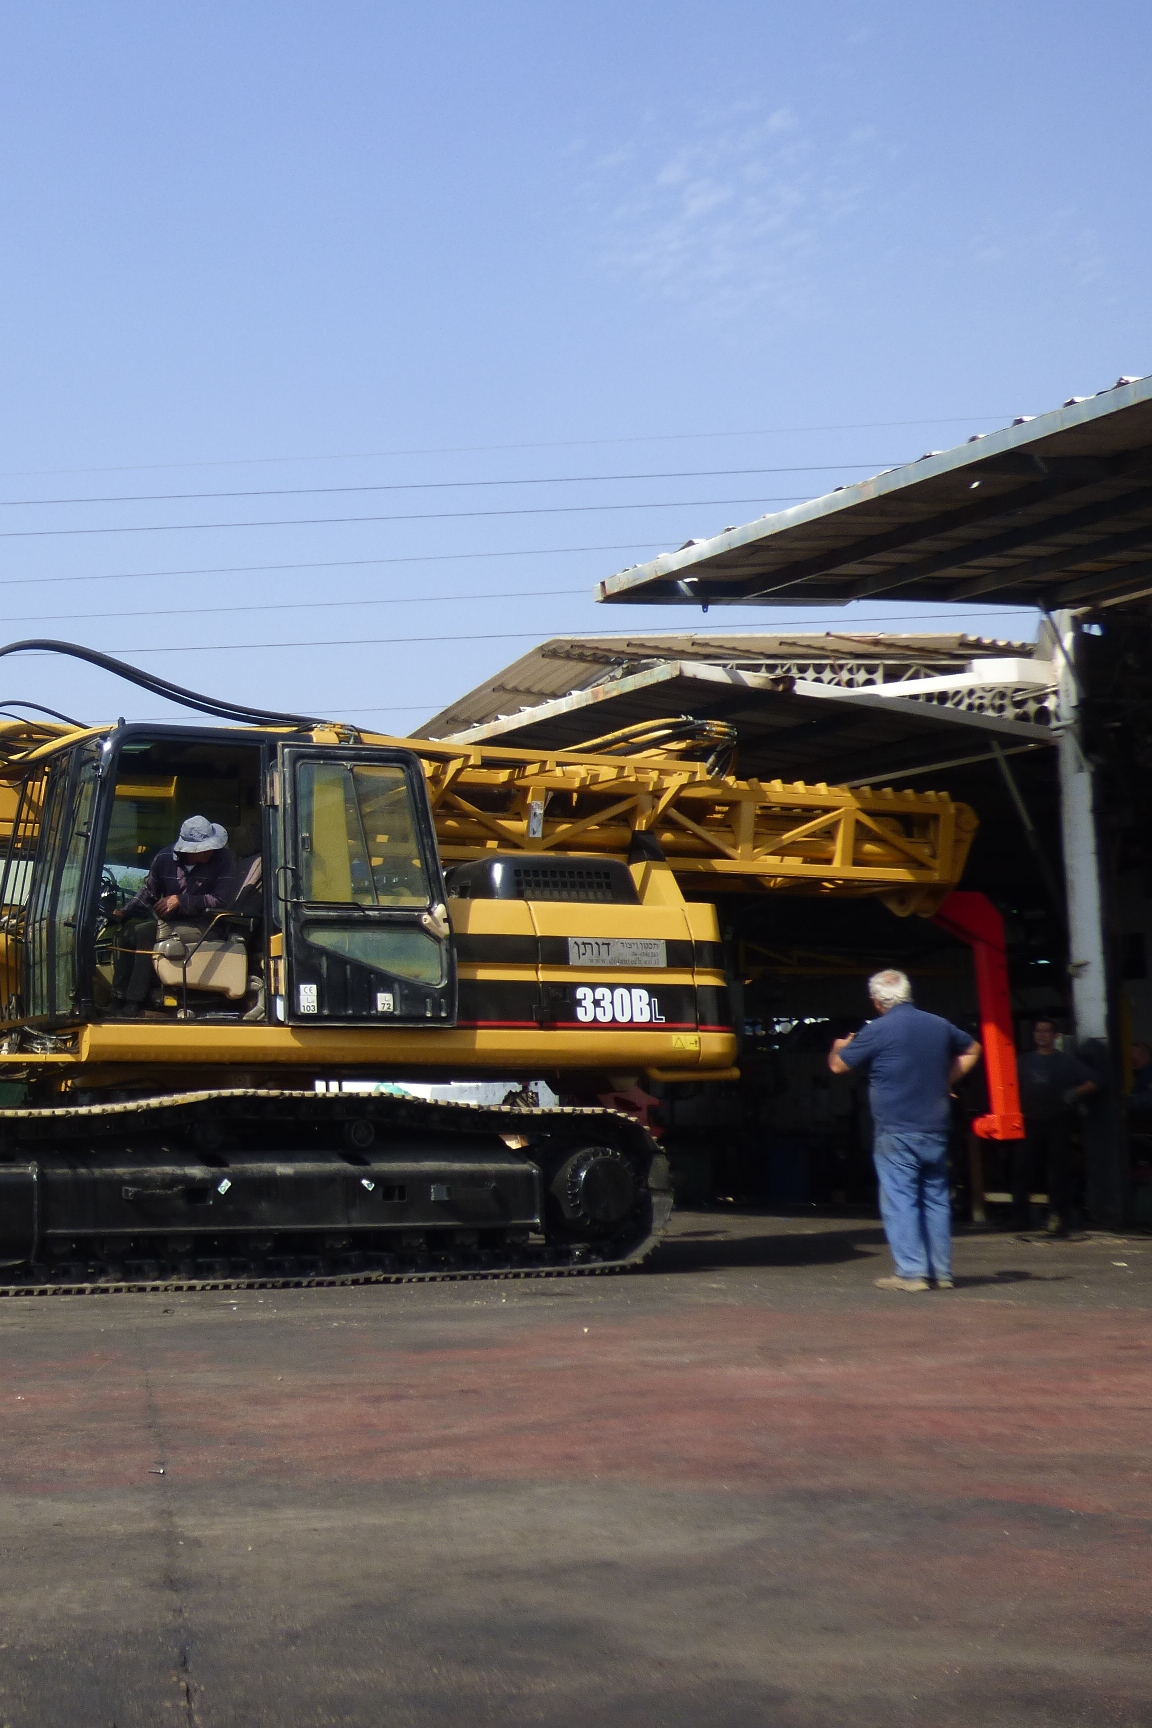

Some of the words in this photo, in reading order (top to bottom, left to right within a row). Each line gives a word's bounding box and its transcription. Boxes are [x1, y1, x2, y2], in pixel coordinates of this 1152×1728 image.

[574, 941, 611, 960] דותן
[303, 986, 314, 995] CE
[302, 1004, 316, 1013] 103
[381, 1002, 392, 1010] 72
